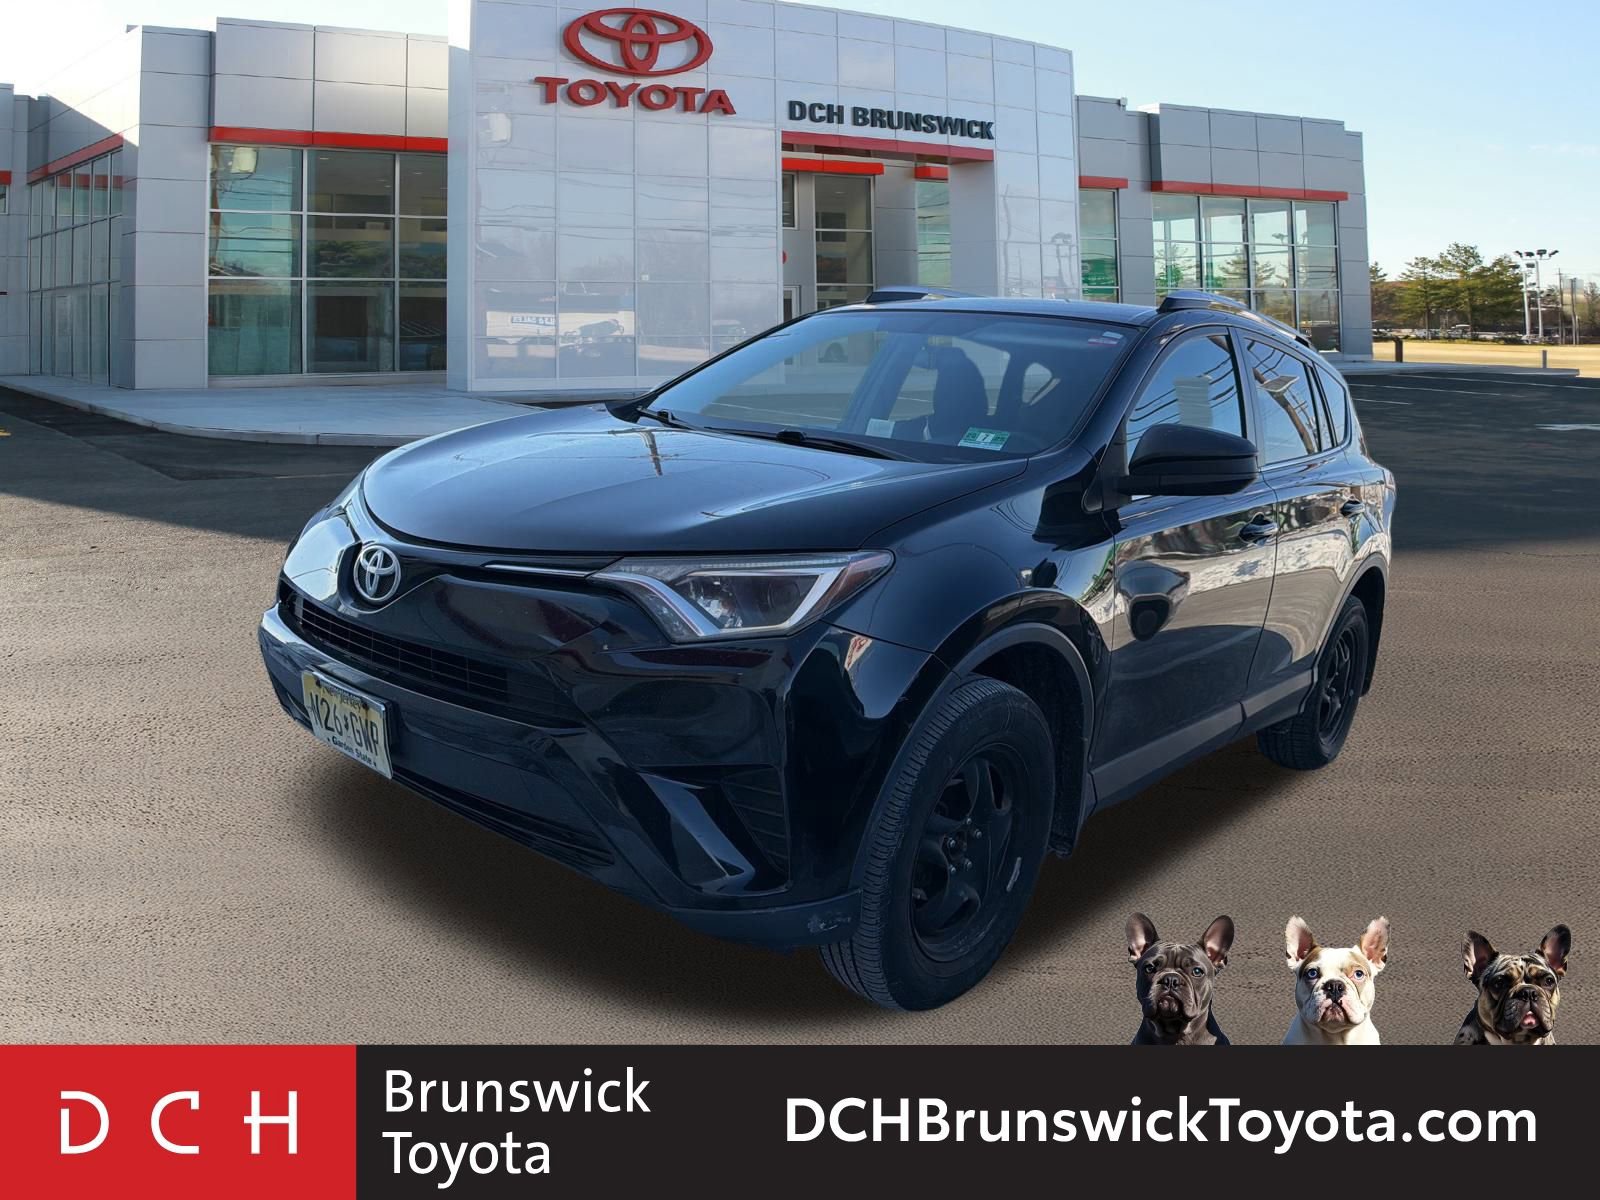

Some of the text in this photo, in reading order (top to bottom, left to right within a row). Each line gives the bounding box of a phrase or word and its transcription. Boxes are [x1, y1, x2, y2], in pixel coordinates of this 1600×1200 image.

[535, 76, 736, 115] TOYOTA
[789, 101, 994, 139] DCH BRUNSWICK
